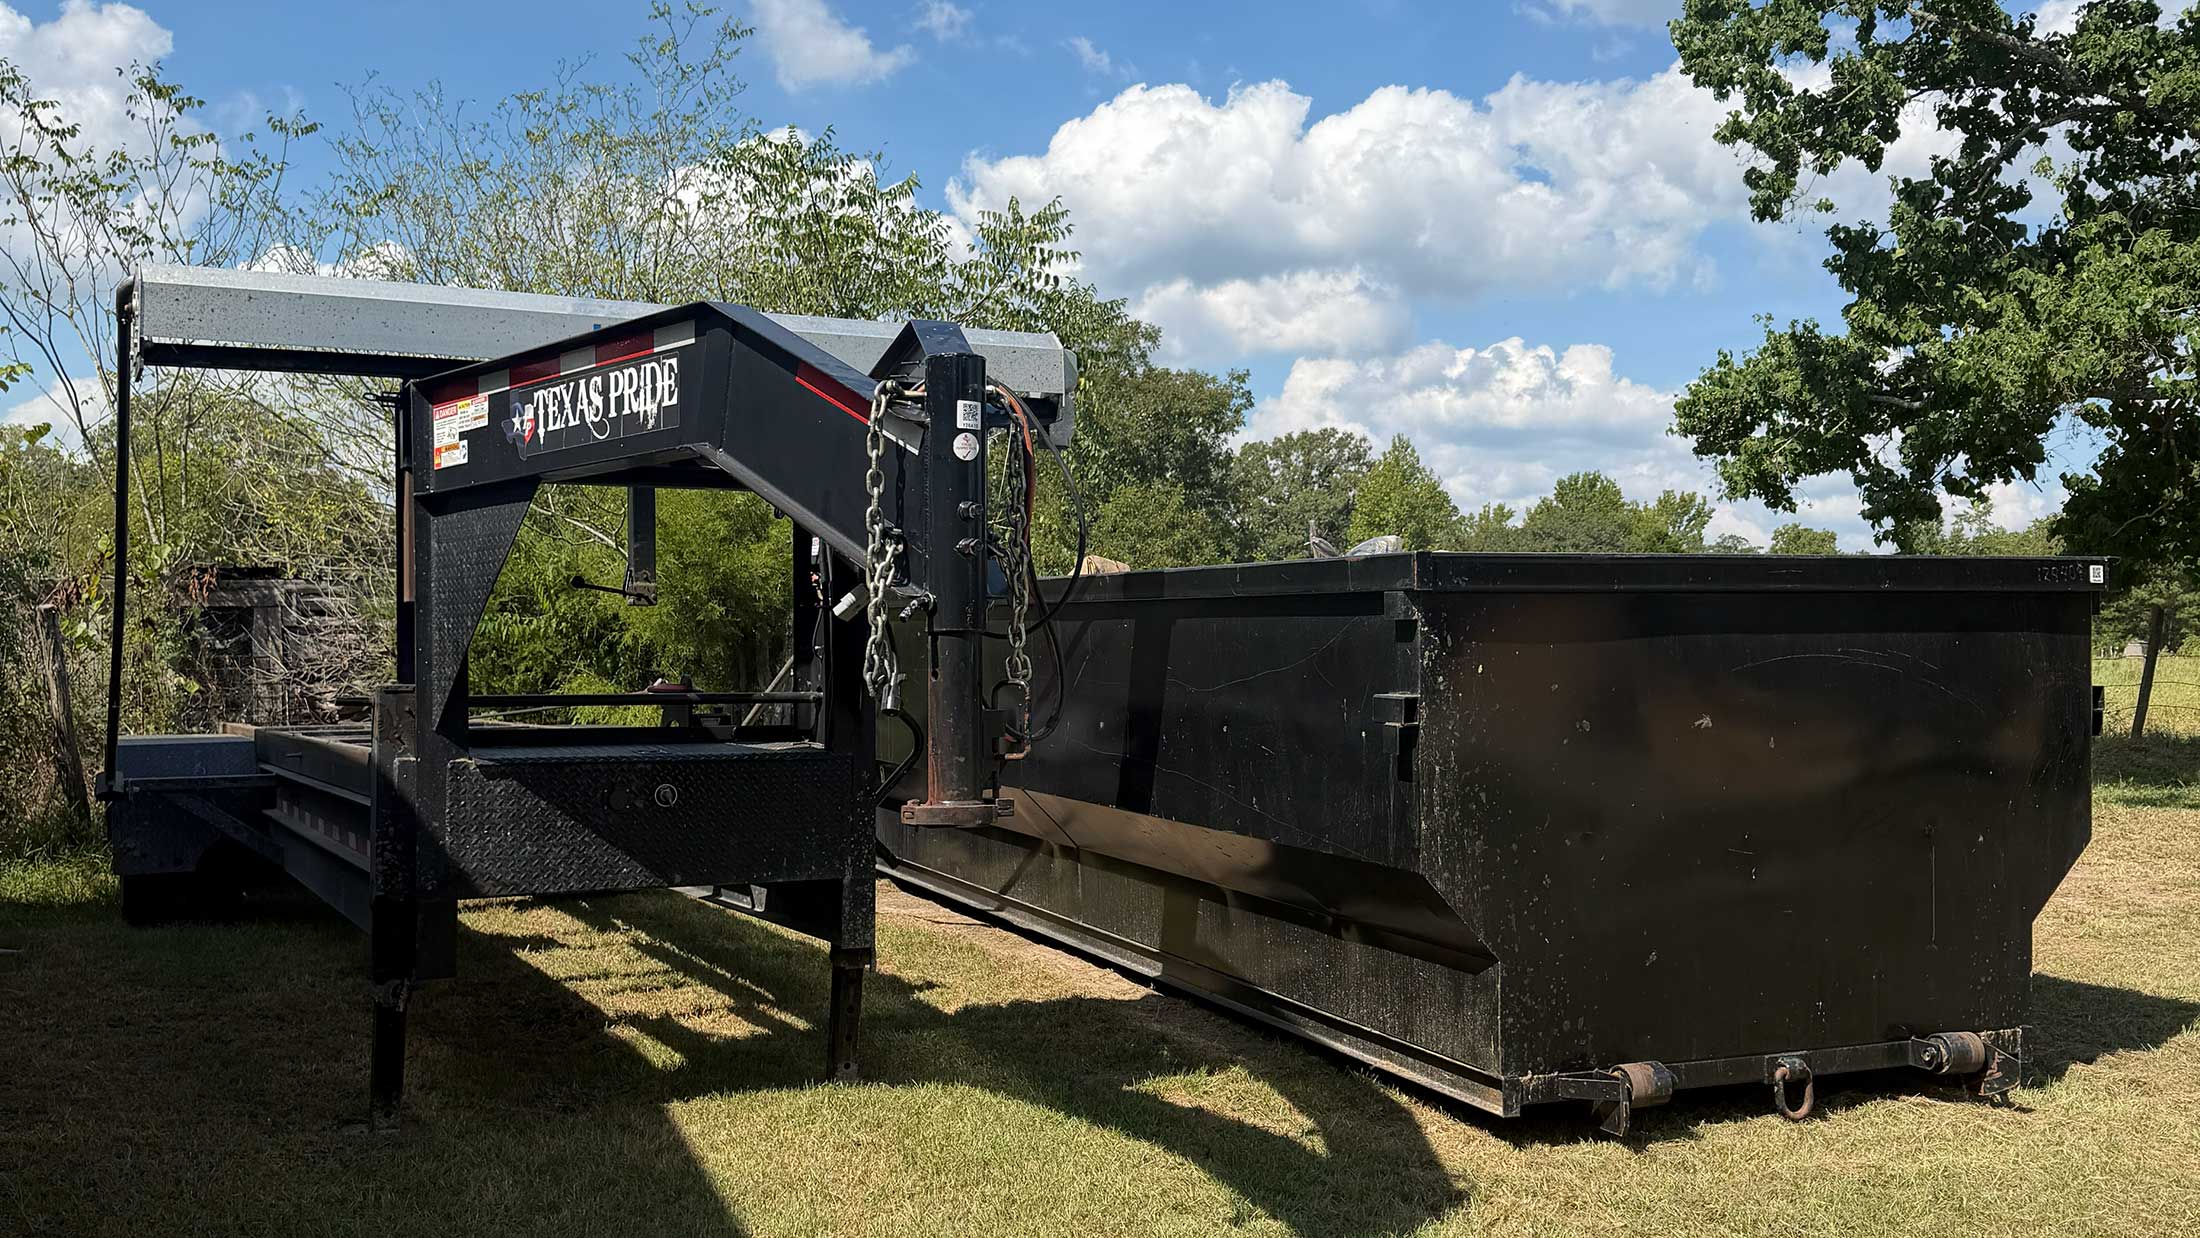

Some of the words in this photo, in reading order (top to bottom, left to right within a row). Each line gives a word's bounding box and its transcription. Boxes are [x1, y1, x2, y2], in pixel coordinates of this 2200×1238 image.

[439, 405, 458, 419] DANGER
[533, 375, 610, 444] TEXAS
[608, 358, 678, 429] PRIDE
